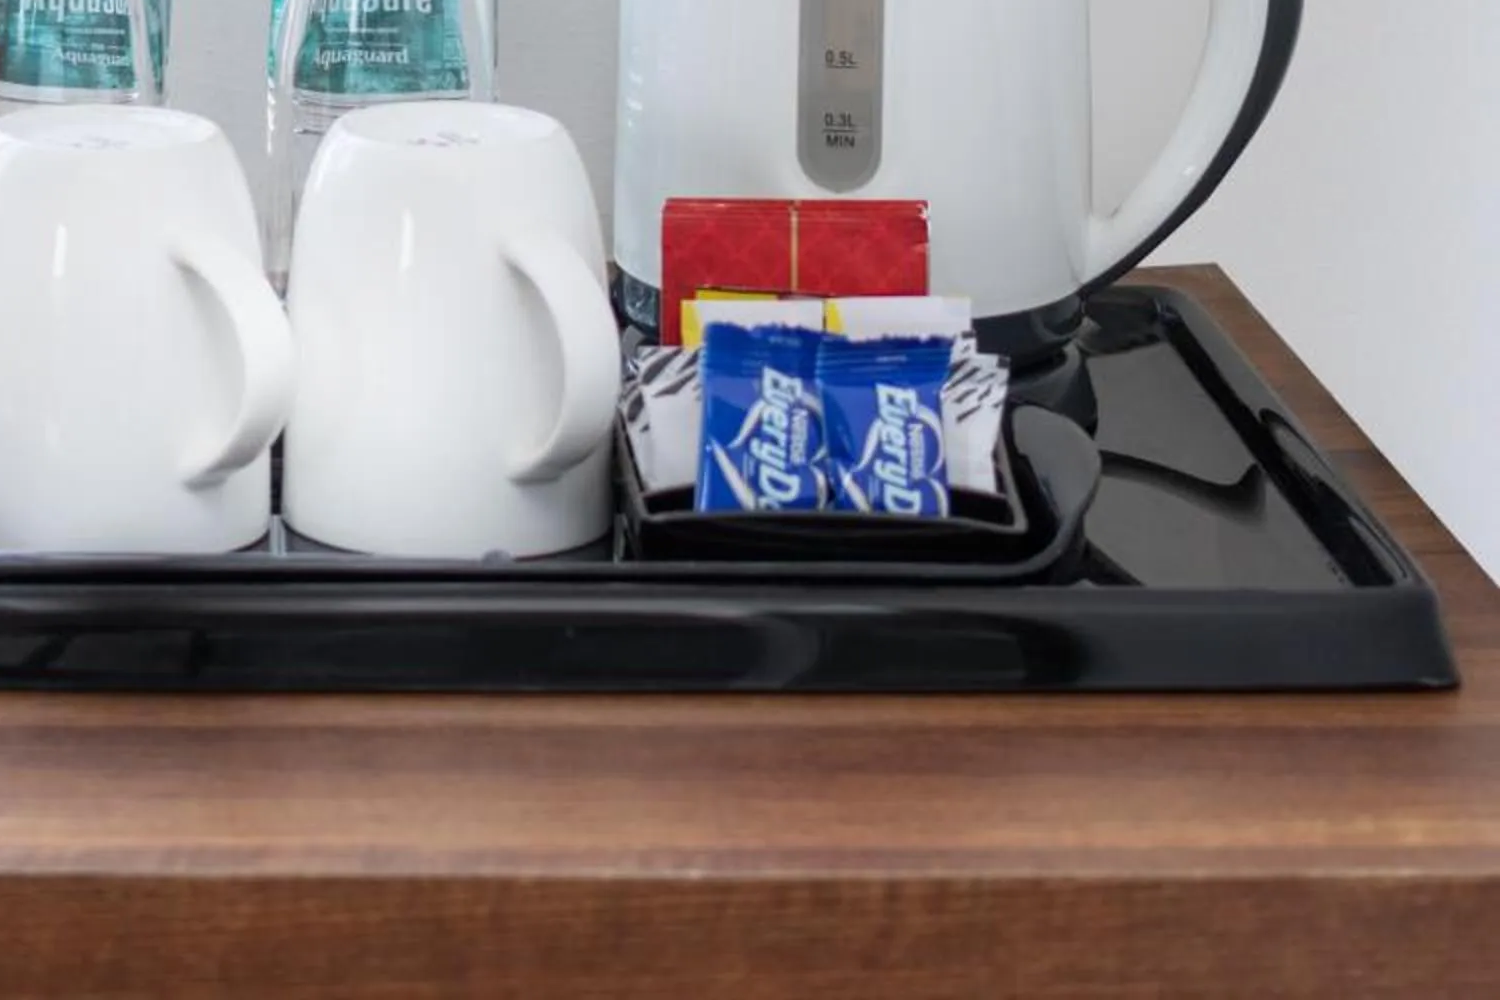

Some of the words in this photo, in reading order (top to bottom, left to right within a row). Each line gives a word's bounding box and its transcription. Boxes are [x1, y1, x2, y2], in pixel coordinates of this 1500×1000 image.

[825, 50, 857, 66] 0.5L
[824, 113, 856, 127] 0.3L
[825, 135, 856, 148] MIN
[874, 383, 922, 514] EveryD
